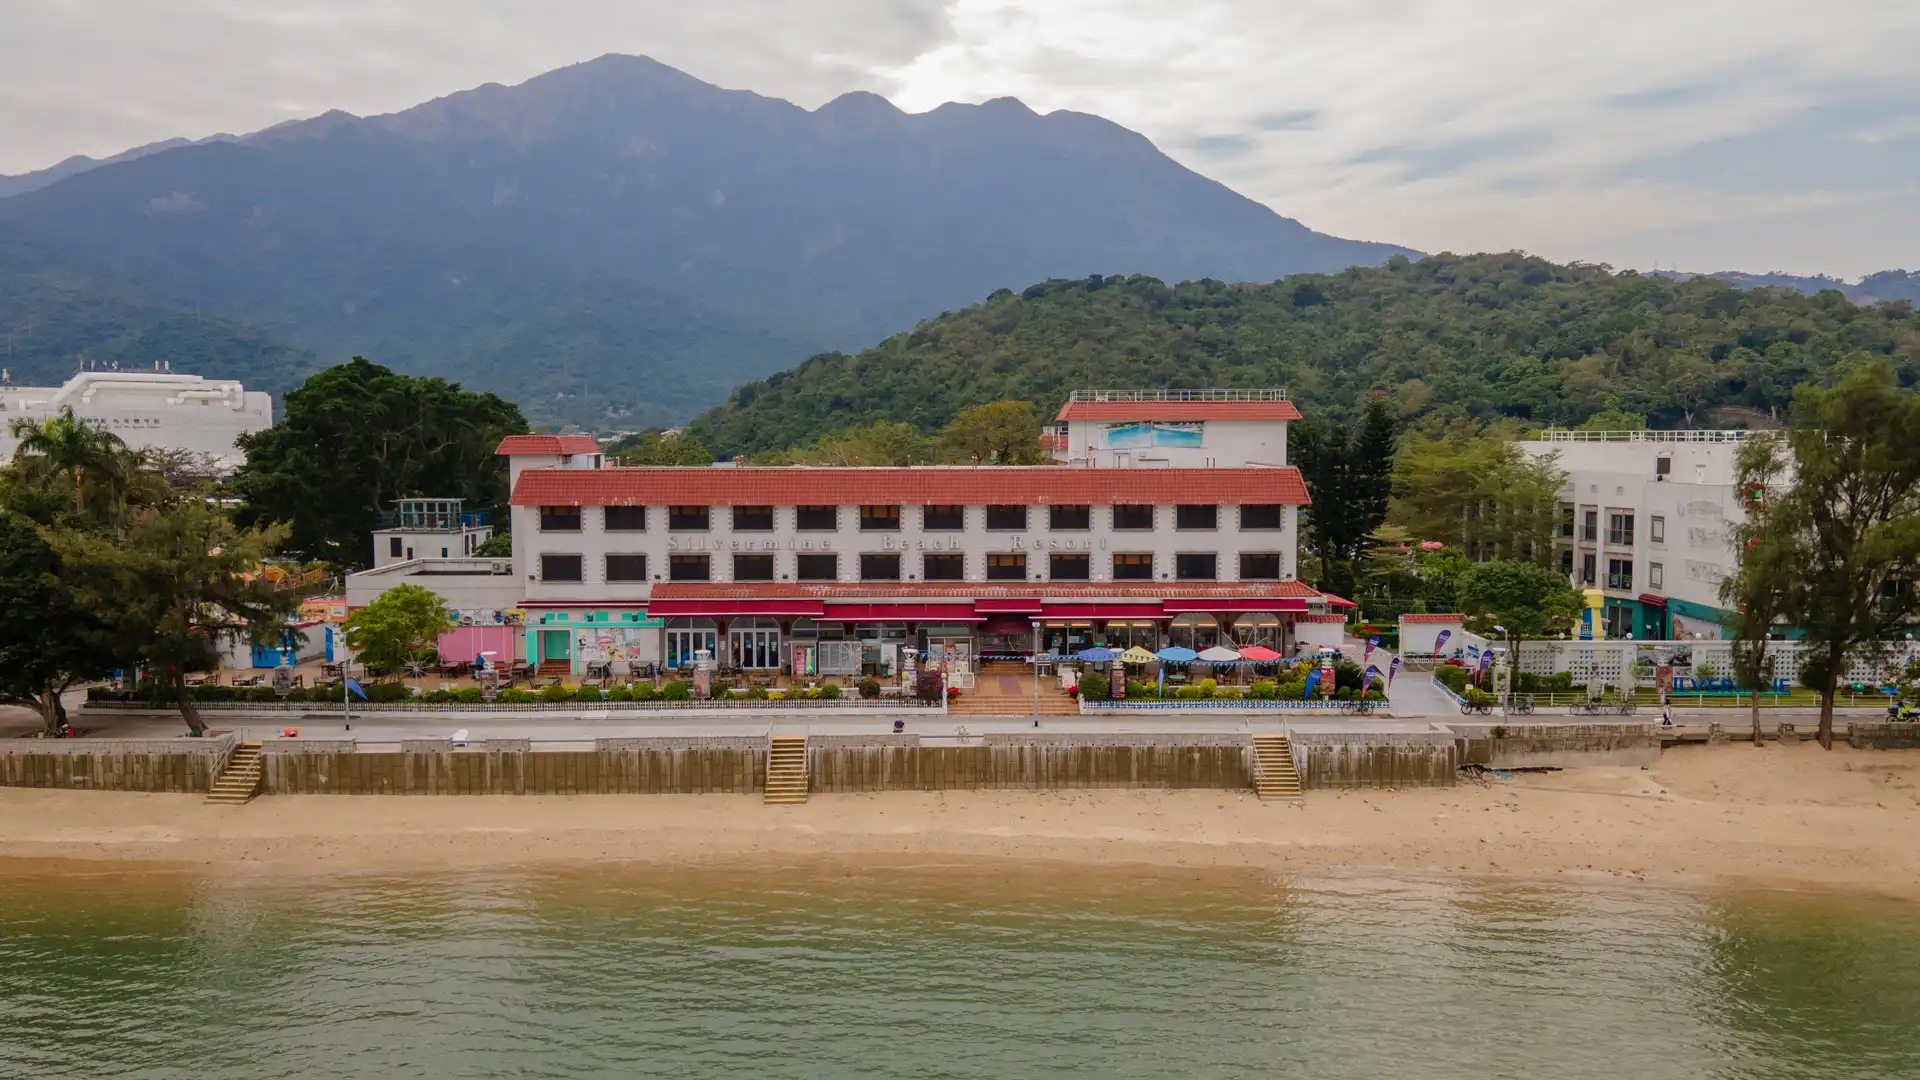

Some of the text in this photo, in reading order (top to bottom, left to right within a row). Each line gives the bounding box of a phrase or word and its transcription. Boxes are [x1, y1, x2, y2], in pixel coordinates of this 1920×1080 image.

[668, 535, 1107, 550] Silvermine Beach Resort
